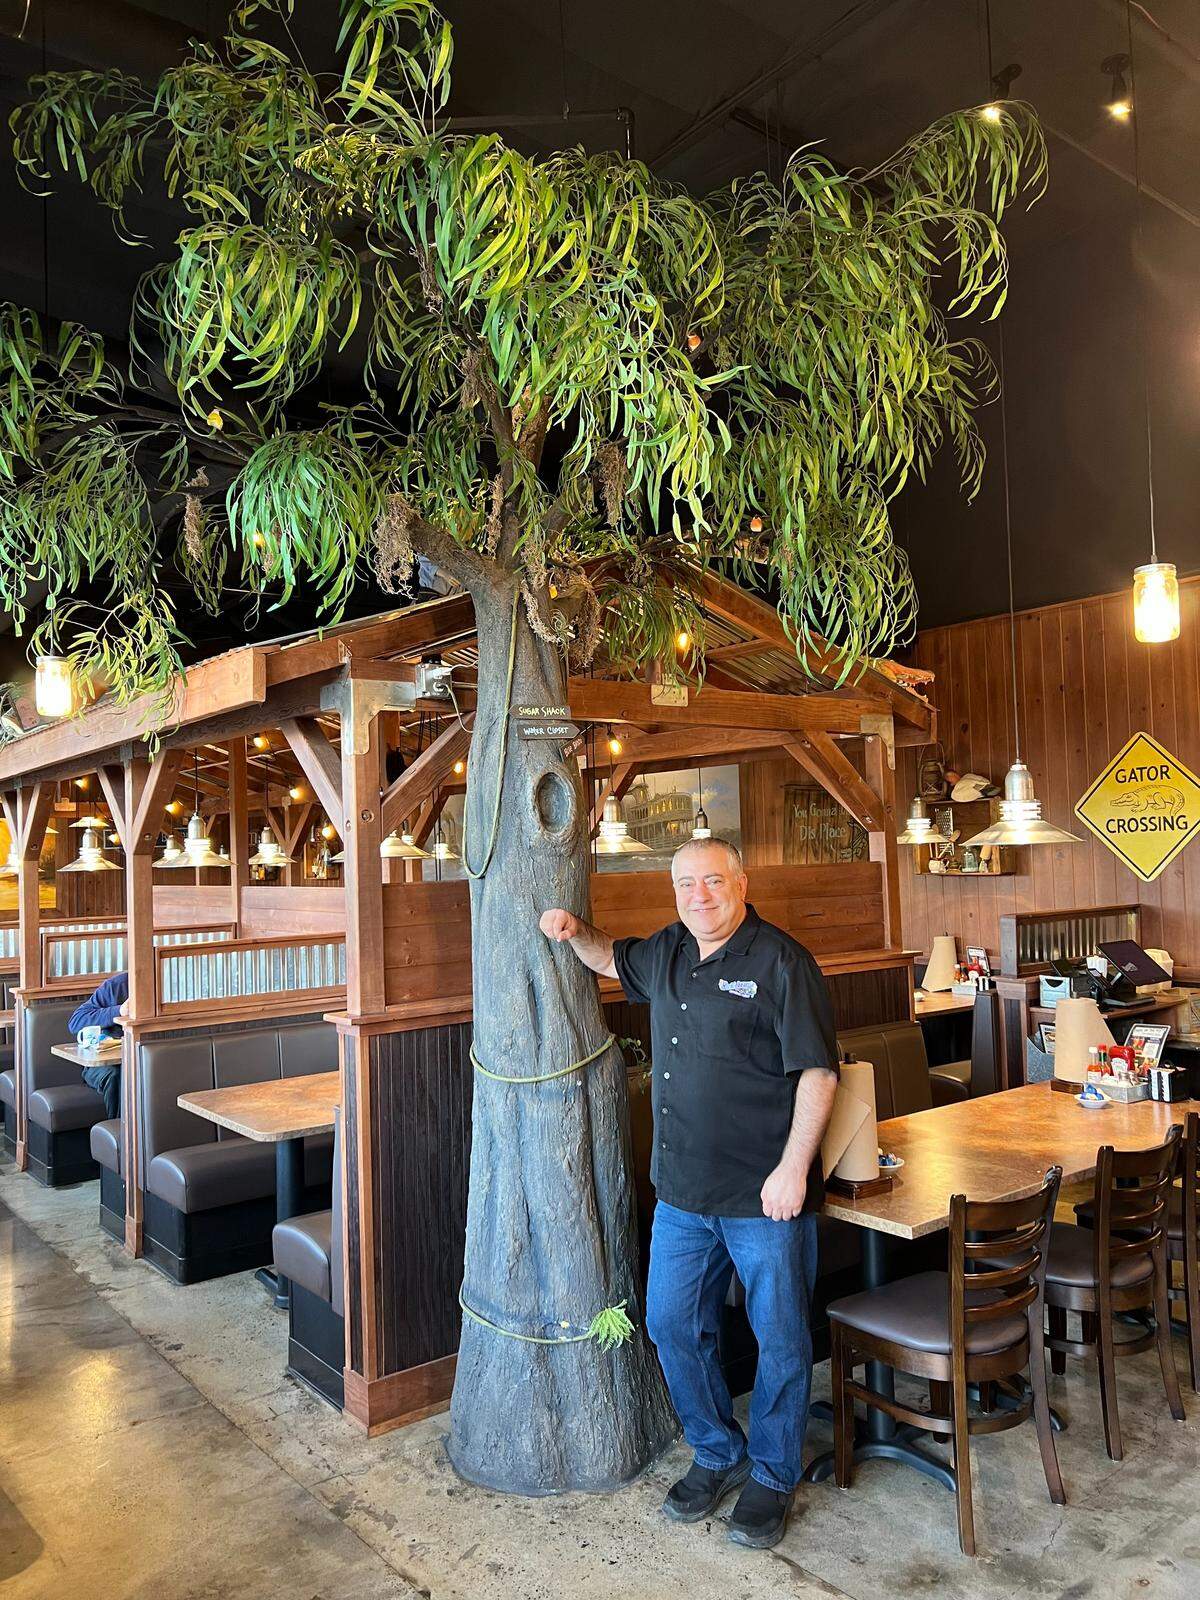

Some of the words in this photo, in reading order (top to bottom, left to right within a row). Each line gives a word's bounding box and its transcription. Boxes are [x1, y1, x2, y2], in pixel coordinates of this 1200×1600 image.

[519, 706, 540, 716] SUGAR
[541, 706, 565, 717] SHACK
[1115, 765, 1171, 784] GATOR
[1106, 815, 1188, 834] CROSSING
